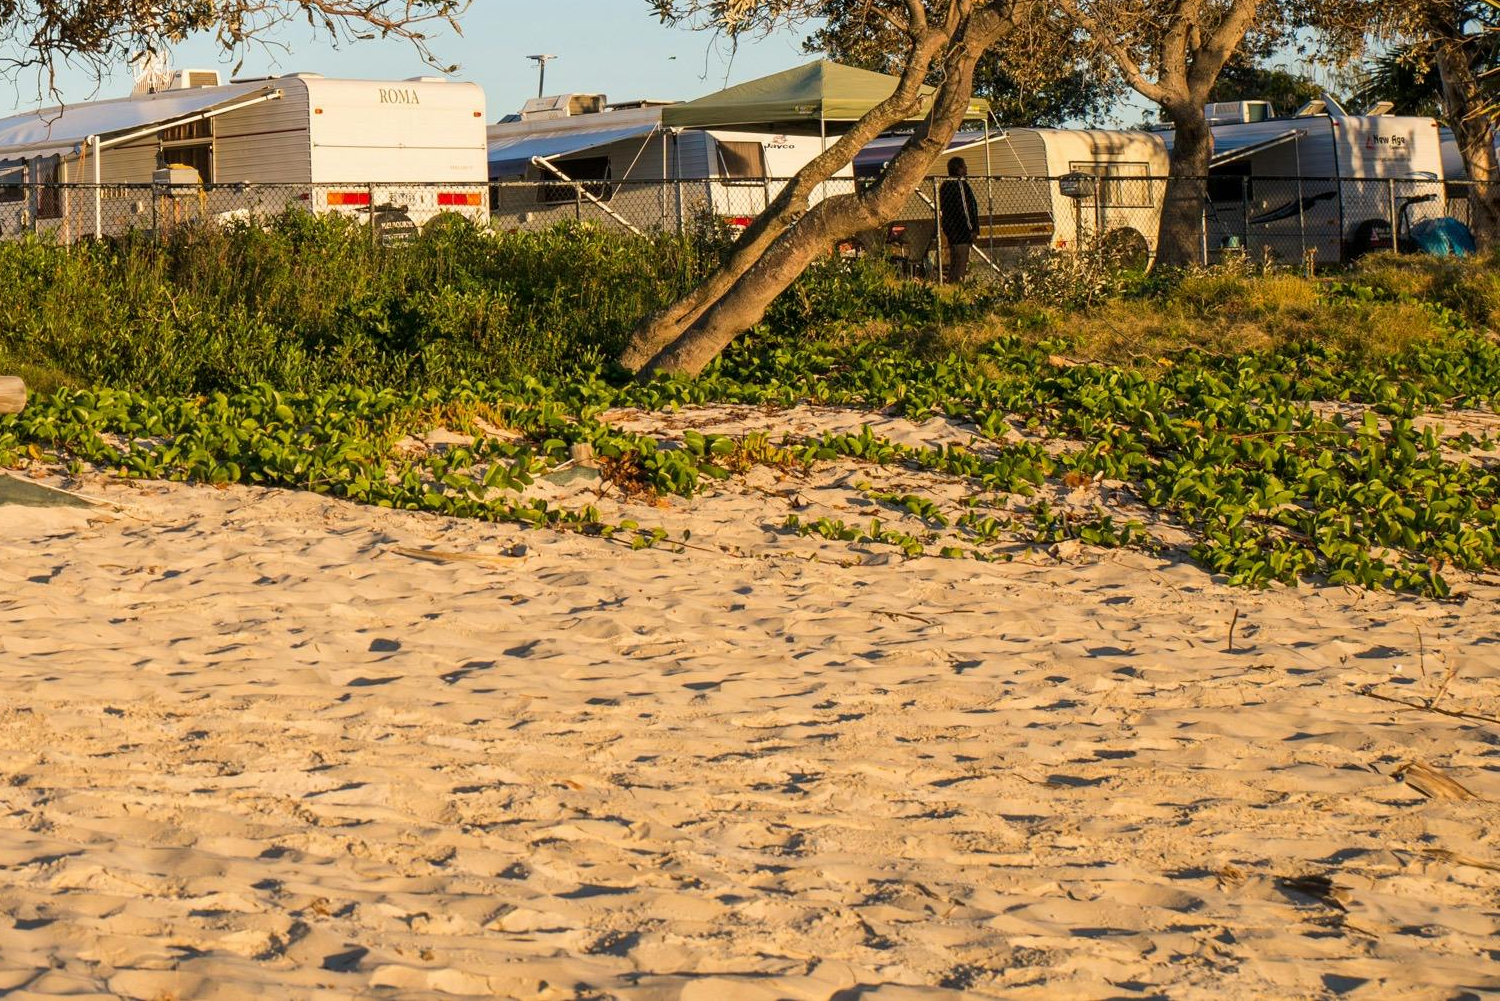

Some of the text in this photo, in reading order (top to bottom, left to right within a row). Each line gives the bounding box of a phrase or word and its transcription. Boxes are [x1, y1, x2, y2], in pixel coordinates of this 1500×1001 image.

[379, 89, 420, 104] ROMA
[1373, 134, 1405, 145] New Age
